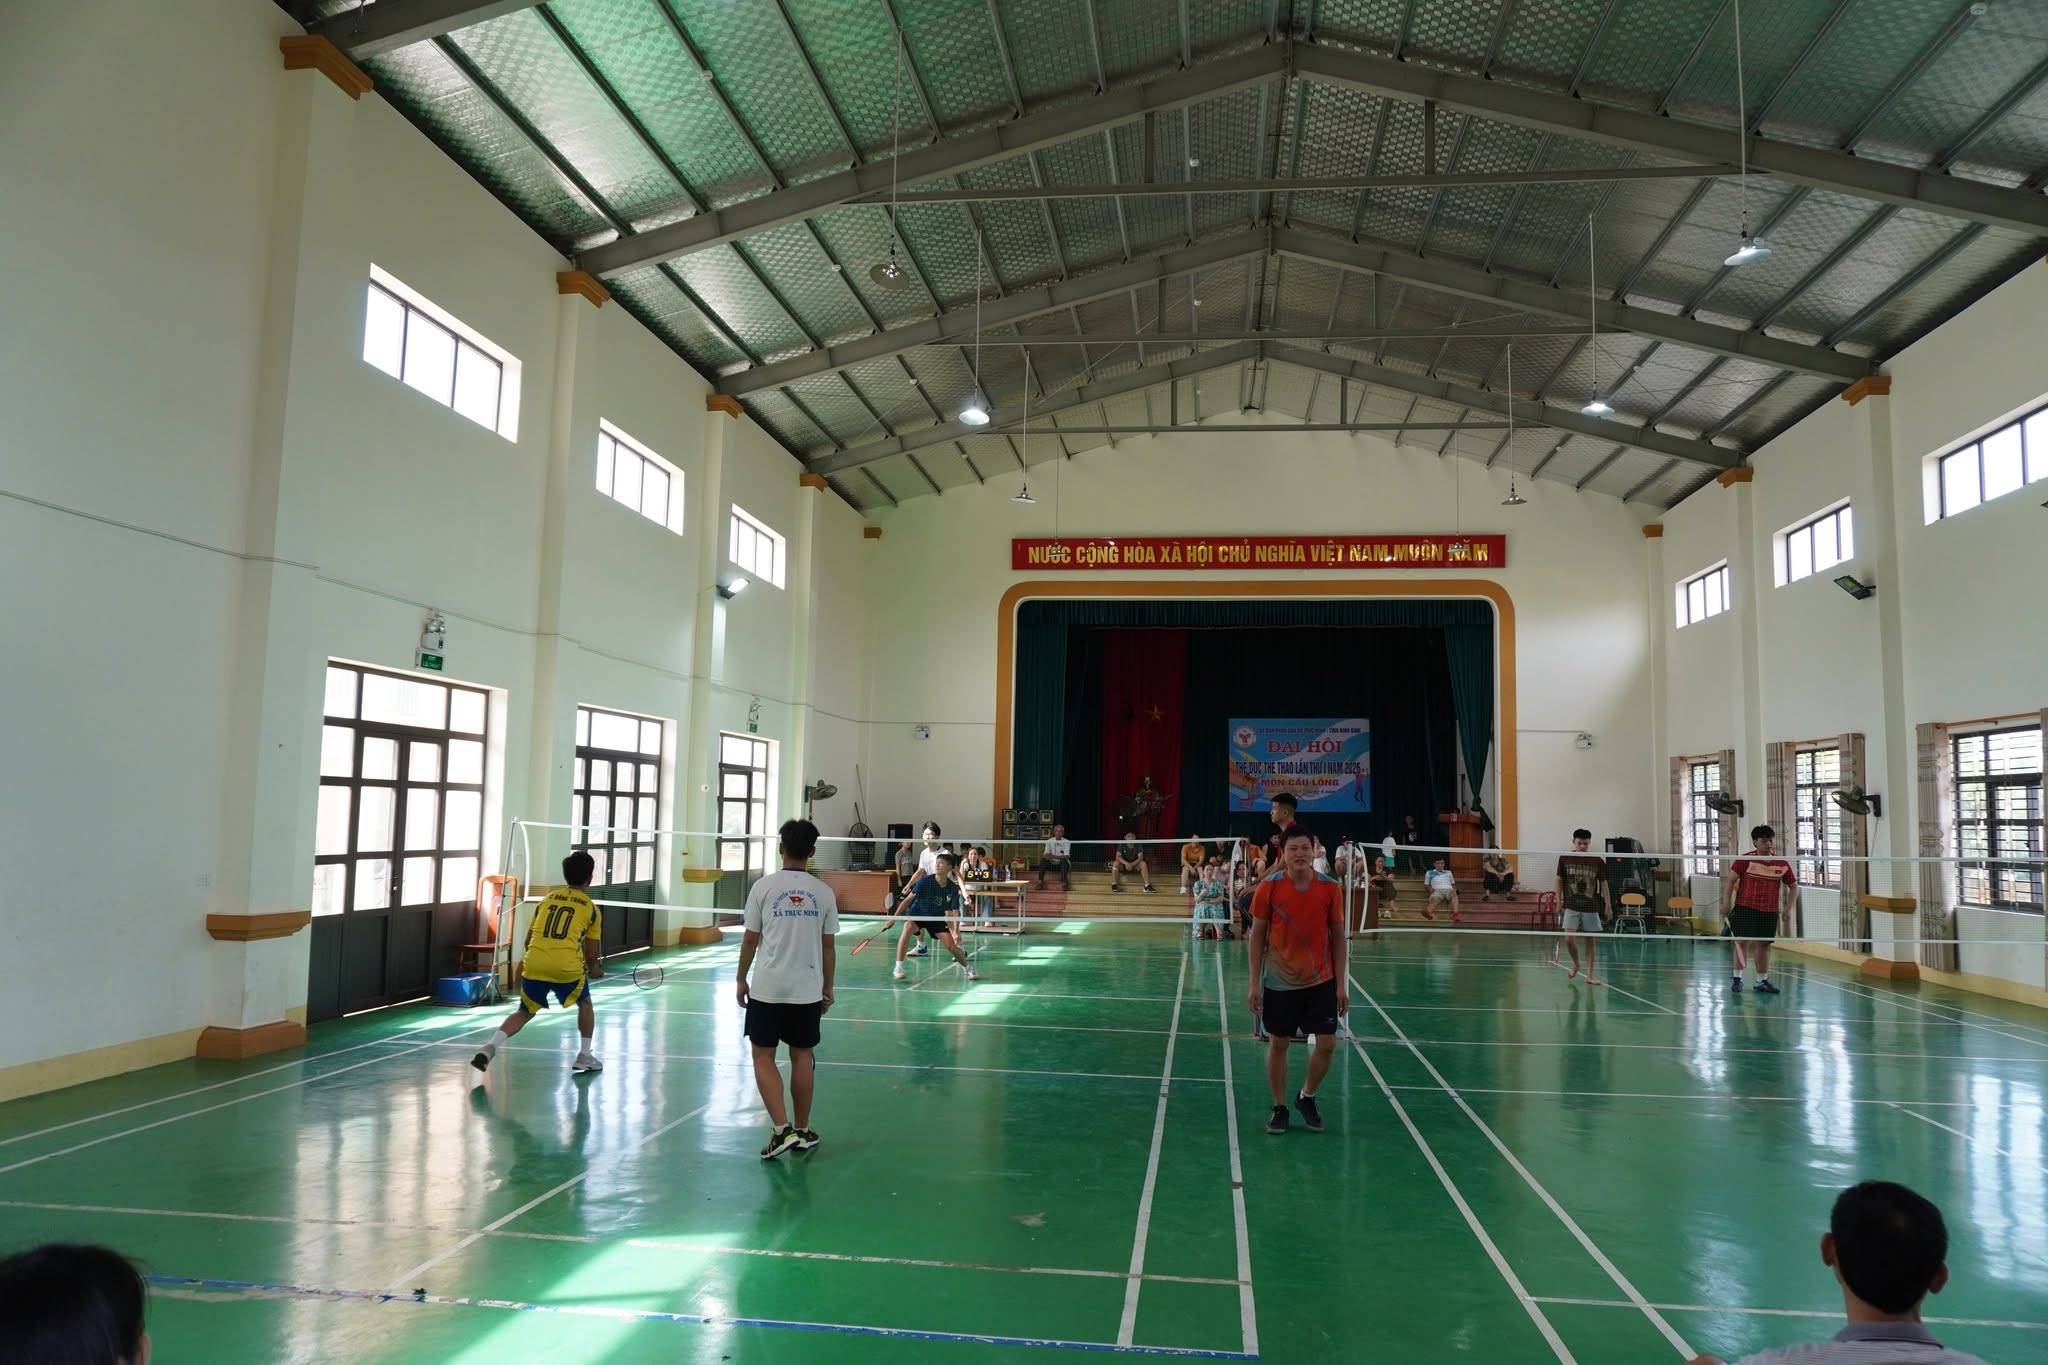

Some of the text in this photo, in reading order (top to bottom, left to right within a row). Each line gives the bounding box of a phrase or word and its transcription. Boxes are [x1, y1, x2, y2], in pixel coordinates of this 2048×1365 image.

[1076, 541, 1119, 567] CỘNG
[1124, 541, 1156, 563] HÒA
[1160, 541, 1182, 563] XÃ
[1187, 541, 1213, 567] HỘI
[1218, 539, 1250, 563] CHỦ
[1255, 540, 1305, 563] NGHĨA
[1311, 540, 1345, 566] VIỆT
[1349, 544, 1388, 563] NAM
[1393, 540, 1443, 563] MUÔN
[1448, 539, 1488, 563] NĂM
[1268, 737, 1341, 756] ĐẠI HỘI
[1277, 761, 1294, 775] THAO
[543, 904, 575, 940] 10
